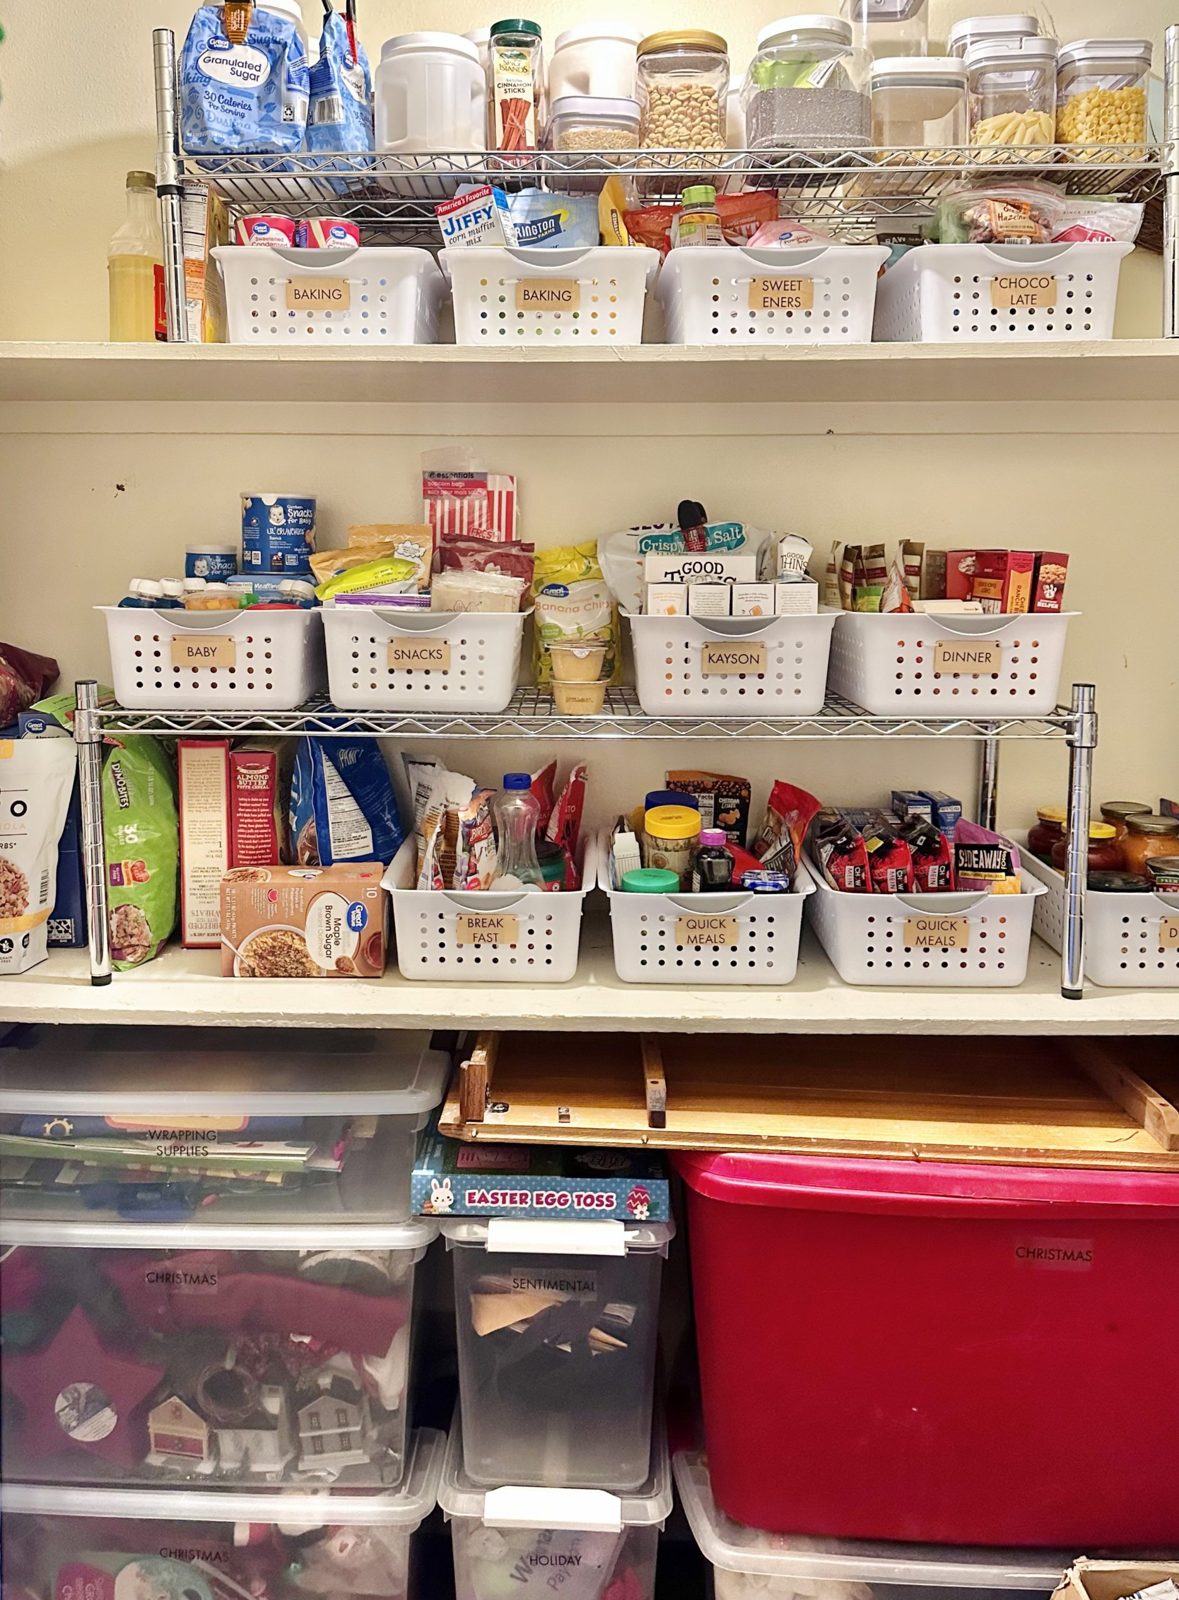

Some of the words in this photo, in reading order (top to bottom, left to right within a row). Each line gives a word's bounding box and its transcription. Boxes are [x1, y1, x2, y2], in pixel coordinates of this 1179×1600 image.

[203, 56, 262, 72] Granulated
[183, 72, 212, 87] king
[230, 67, 260, 82] Sugar
[204, 91, 217, 102] 30
[217, 95, 253, 111] Calories
[219, 106, 246, 119] Serving
[437, 197, 465, 214] America's
[465, 188, 490, 203] Favorite
[443, 205, 493, 236] JIFFY
[449, 233, 466, 245] corn
[468, 221, 495, 237] muffin
[516, 218, 555, 239] RINGTON
[466, 236, 482, 247] mix
[762, 280, 802, 292] SWEET
[999, 277, 1050, 289] CHOCO
[294, 289, 342, 300] BAKING
[523, 289, 572, 302] BAKING
[1010, 294, 1037, 306] LATE
[763, 296, 801, 308] ENERS
[288, 508, 312, 518] Snacks
[713, 527, 741, 543] Salt
[641, 537, 687, 554] Crispy
[786, 552, 805, 561] GOOD
[682, 561, 724, 575] GOOD
[535, 601, 580, 613] Banana
[187, 647, 218, 657] BABY
[394, 649, 443, 660] SNACKS
[942, 651, 992, 664] DINNER
[708, 653, 760, 665] KAYSON
[125, 823, 138, 844] 30
[889, 870, 897, 891] MEIN
[930, 867, 938, 886] MEIN
[367, 887, 378, 899] 10
[325, 905, 333, 932] Brown
[467, 918, 504, 928] BREAK
[686, 918, 726, 930] QUICK
[334, 917, 342, 946] Maple
[916, 920, 958, 931] QUICK
[472, 933, 499, 943] FAST
[686, 934, 725, 944] MEALS
[1169, 927, 1178, 938] D
[325, 933, 333, 959] Sugar
[915, 936, 956, 946] MEALS
[148, 1129, 217, 1144] WRAPPING
[156, 1145, 209, 1157] SUPPLIES
[467, 1189, 529, 1206] EASTER
[536, 1193, 569, 1207] EGG
[575, 1194, 616, 1209] TOSS
[1016, 1246, 1093, 1262] CHRISTMAS
[146, 1271, 217, 1287] CHRISTMAS
[512, 1278, 595, 1292] SENTIMENTAL
[159, 1547, 230, 1564] CHRISTMAS
[529, 1556, 582, 1567] HOLIDAY
